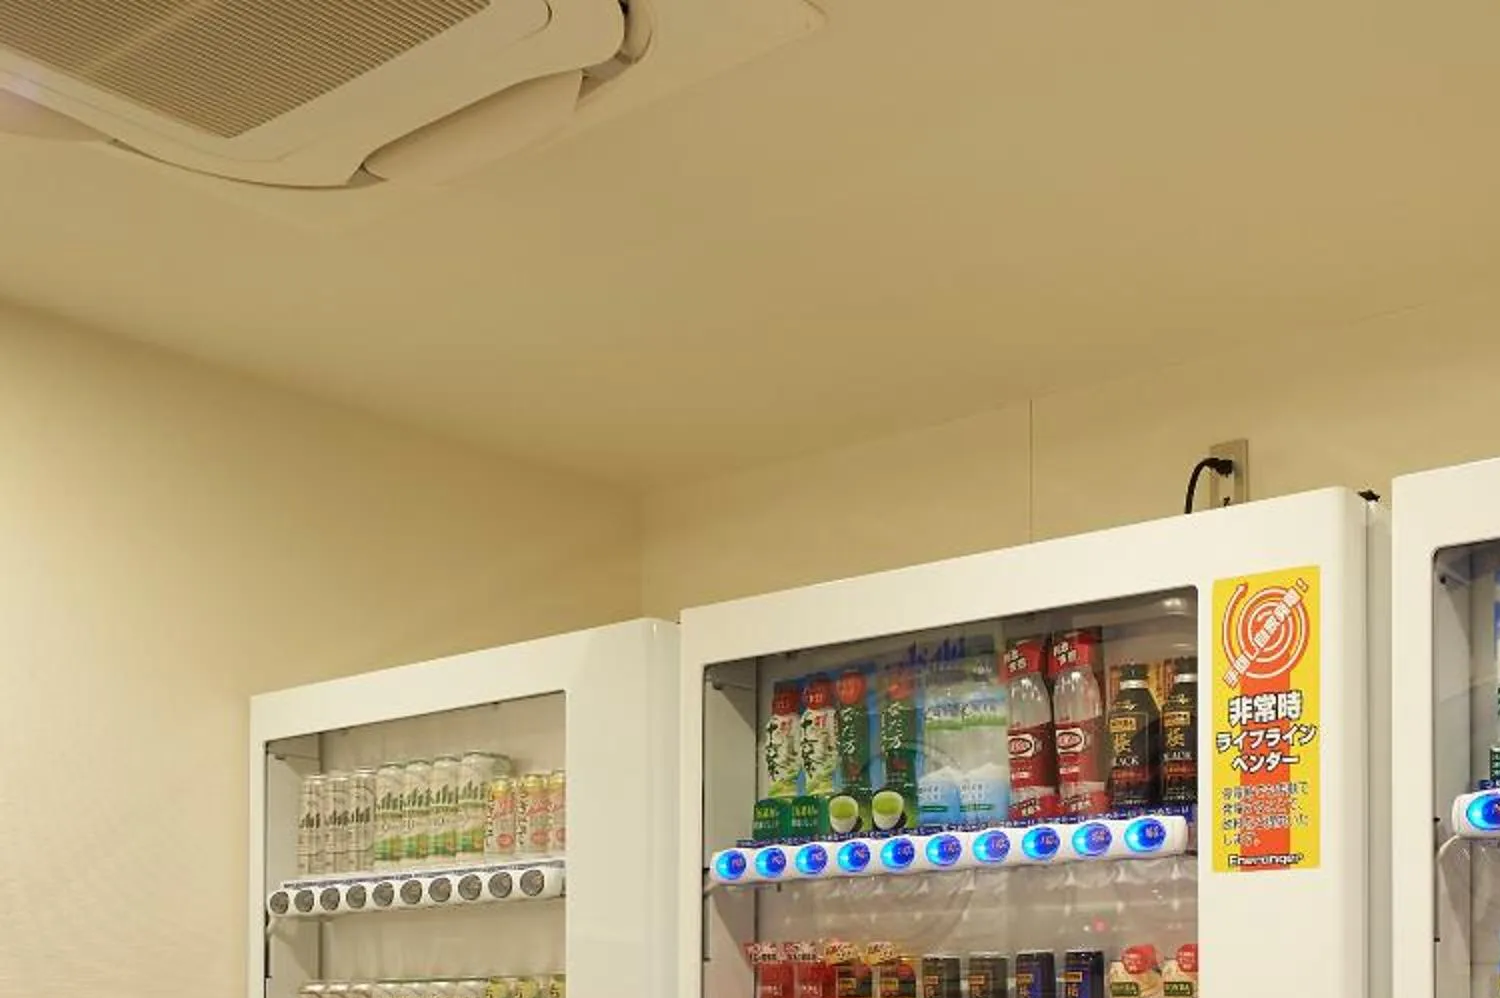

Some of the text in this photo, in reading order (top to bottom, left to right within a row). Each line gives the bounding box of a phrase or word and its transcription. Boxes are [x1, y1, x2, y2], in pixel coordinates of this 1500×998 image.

[1229, 691, 1302, 725] 非常時
[1216, 724, 1316, 752] ライフライン
[1232, 752, 1300, 773] ベンダー
